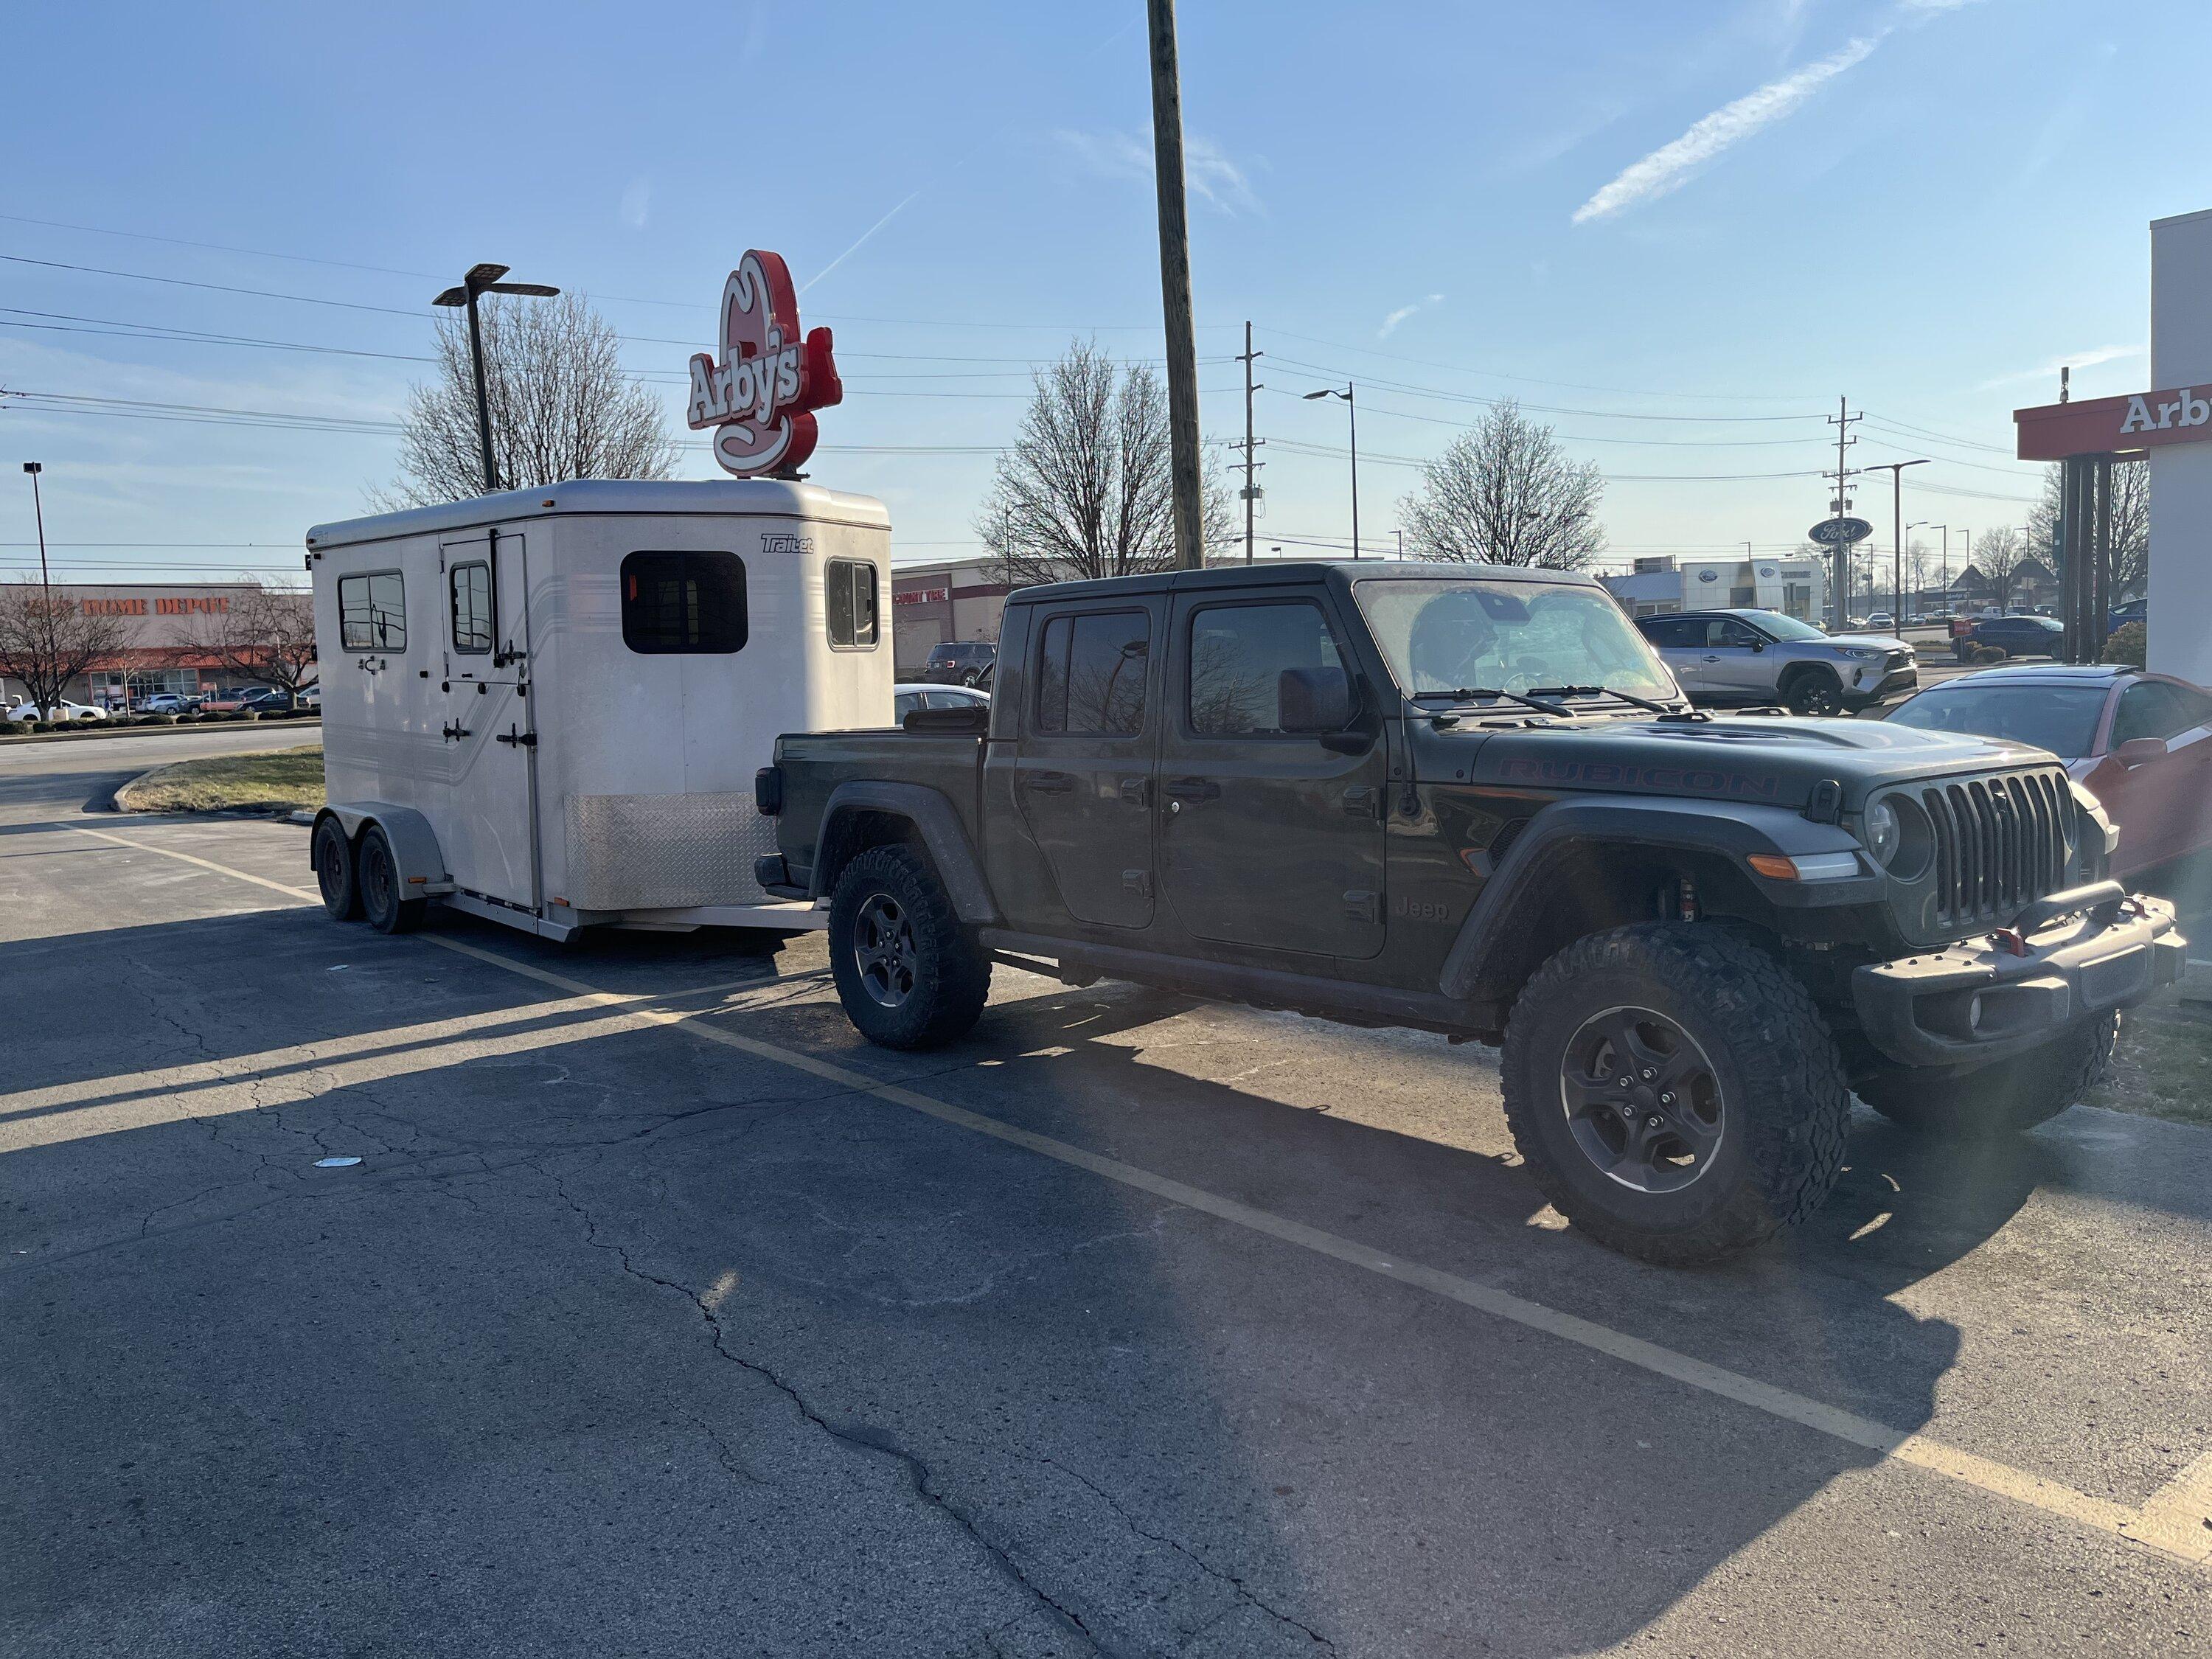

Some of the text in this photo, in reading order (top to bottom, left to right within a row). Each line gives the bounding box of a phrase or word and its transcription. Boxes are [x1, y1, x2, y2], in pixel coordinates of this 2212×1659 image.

[690, 330, 798, 424] Arby's
[2120, 389, 2212, 434] Arb
[83, 599, 147, 616] HOME
[156, 597, 229, 615] DEPOT
[925, 588, 946, 602] TIRE
[1499, 759, 1779, 796] RUBICON
[1394, 897, 1449, 925] Jeep
